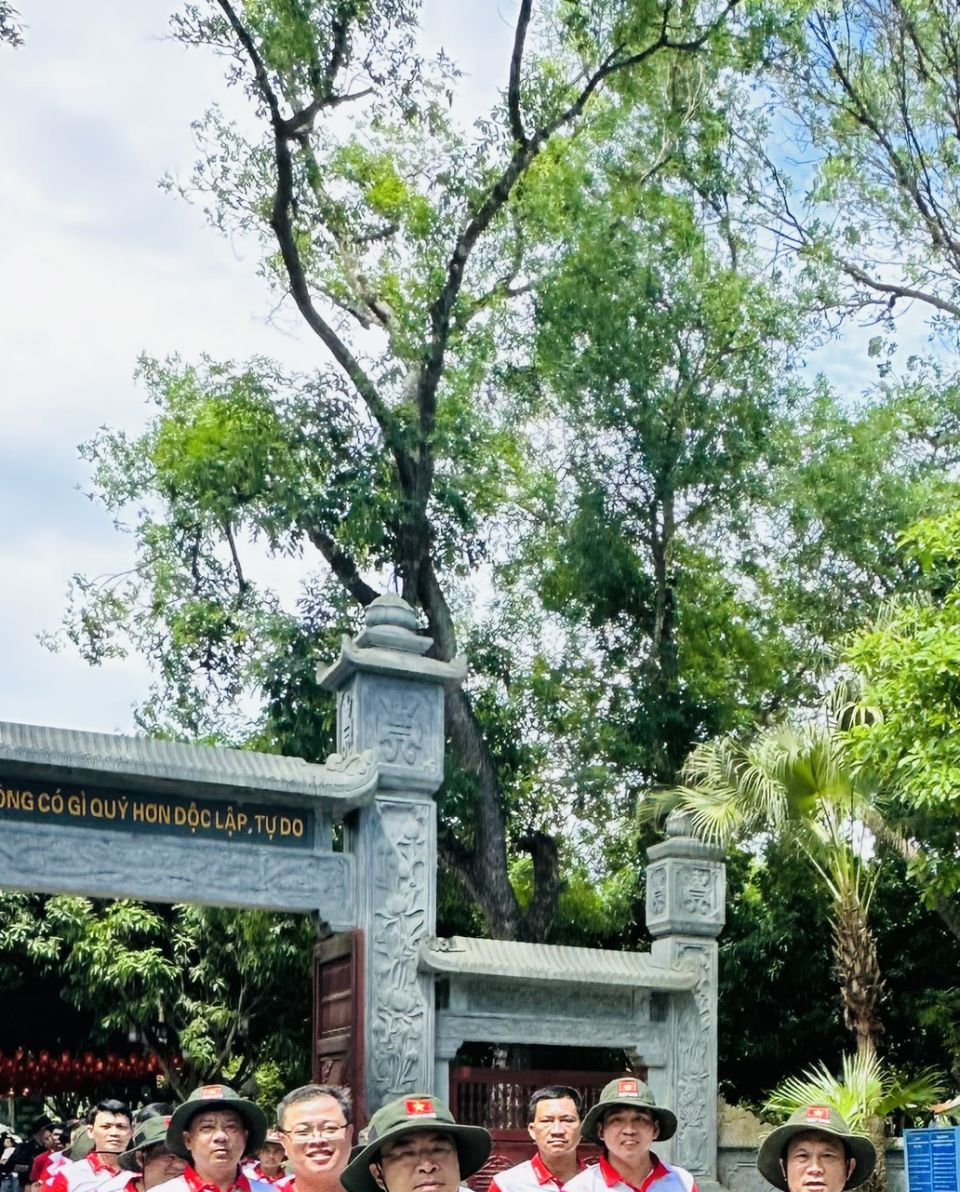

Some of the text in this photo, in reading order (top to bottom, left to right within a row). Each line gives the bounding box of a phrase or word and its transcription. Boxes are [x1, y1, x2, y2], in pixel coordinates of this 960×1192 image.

[37, 788, 64, 814] CÓ
[68, 790, 86, 816] GÌ
[133, 802, 171, 825] HƠN
[254, 815, 277, 841] TỰ
[280, 817, 304, 837] DO
